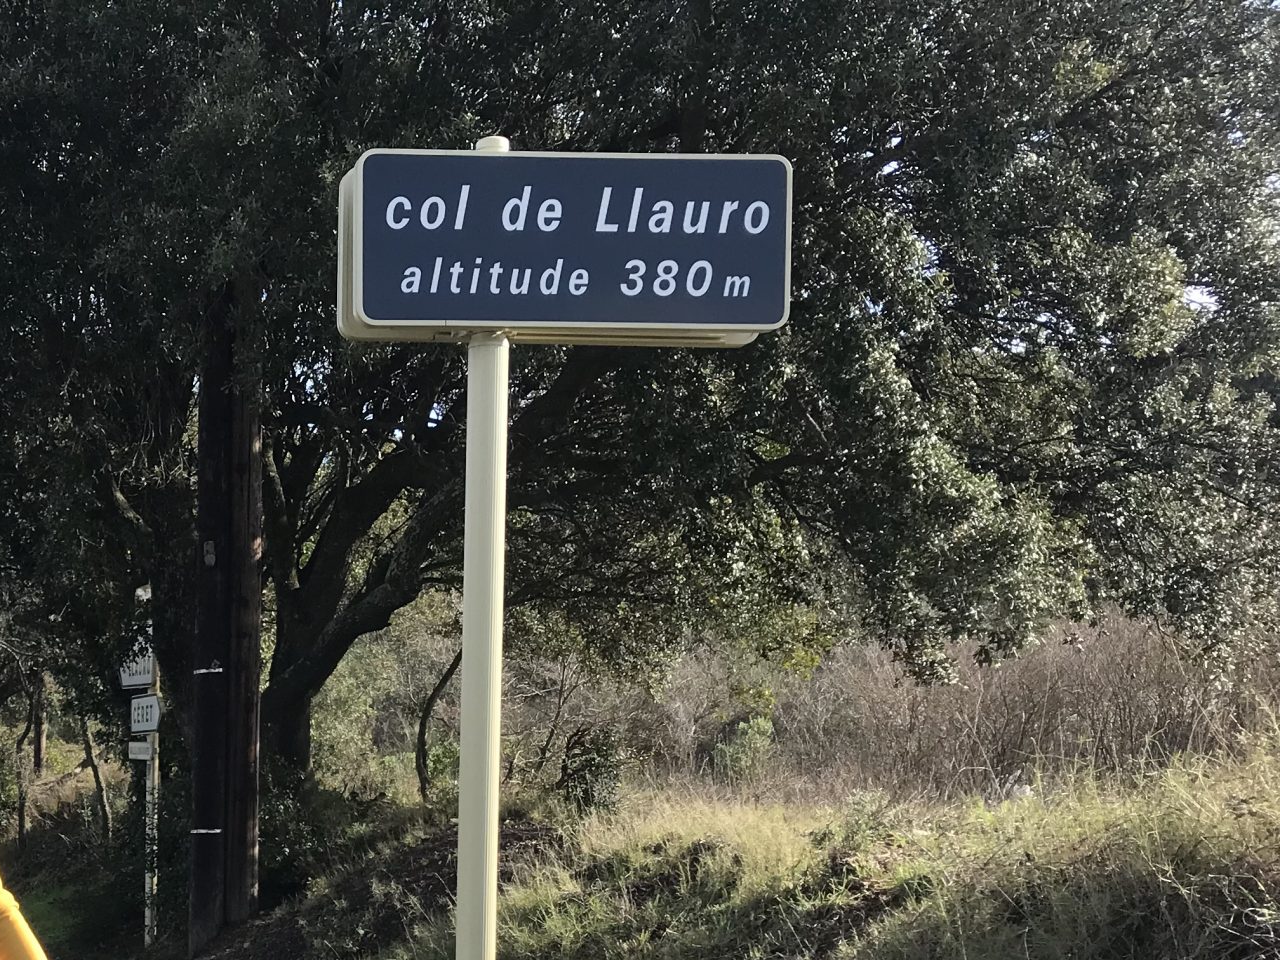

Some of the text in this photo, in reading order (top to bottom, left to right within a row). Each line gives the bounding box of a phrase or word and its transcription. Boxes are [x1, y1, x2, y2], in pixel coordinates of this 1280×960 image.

[385, 184, 771, 234] col de Llauro
[400, 256, 752, 297] altitude 380 m
